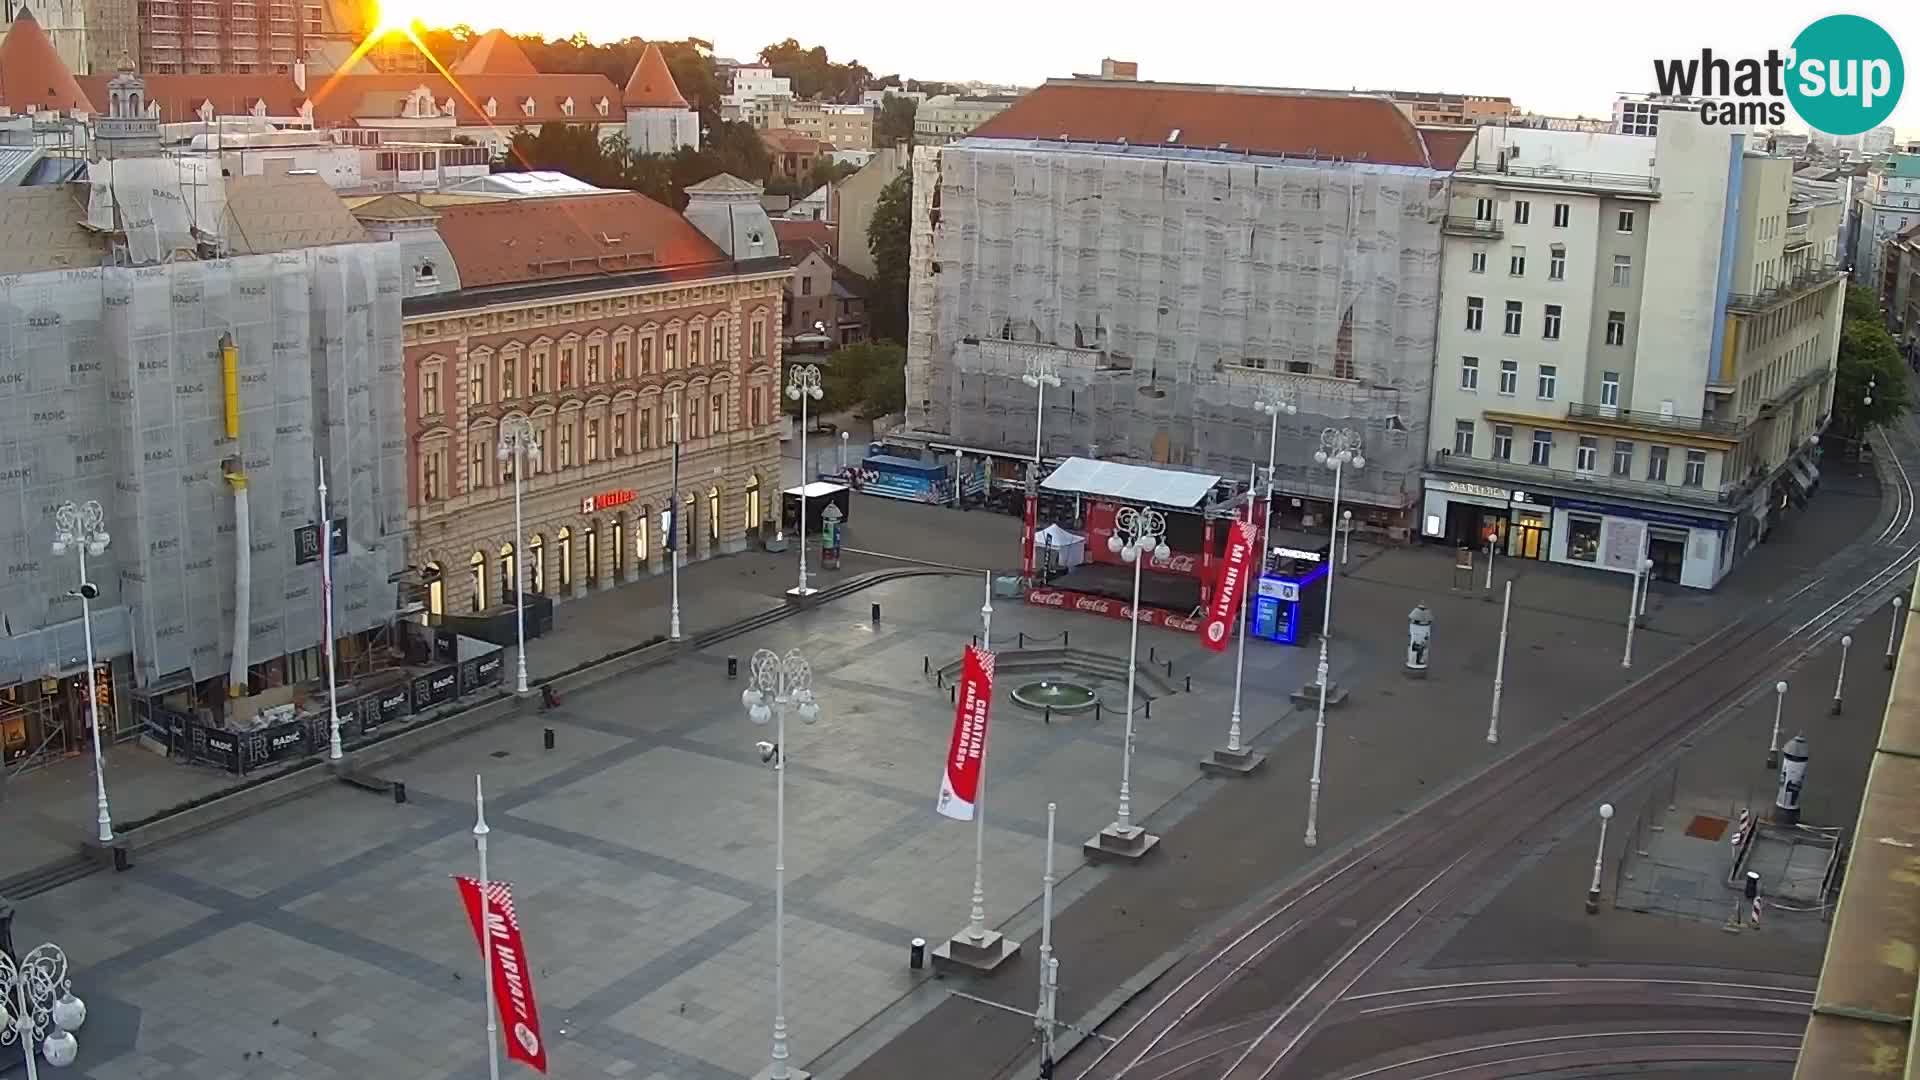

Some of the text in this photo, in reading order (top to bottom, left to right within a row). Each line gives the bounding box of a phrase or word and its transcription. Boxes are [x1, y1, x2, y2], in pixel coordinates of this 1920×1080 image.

[1231, 544, 1245, 564] MI
[955, 713, 973, 770] EMBASSY
[969, 699, 986, 759] CROATIAN
[496, 944, 528, 1020] HRVATI
